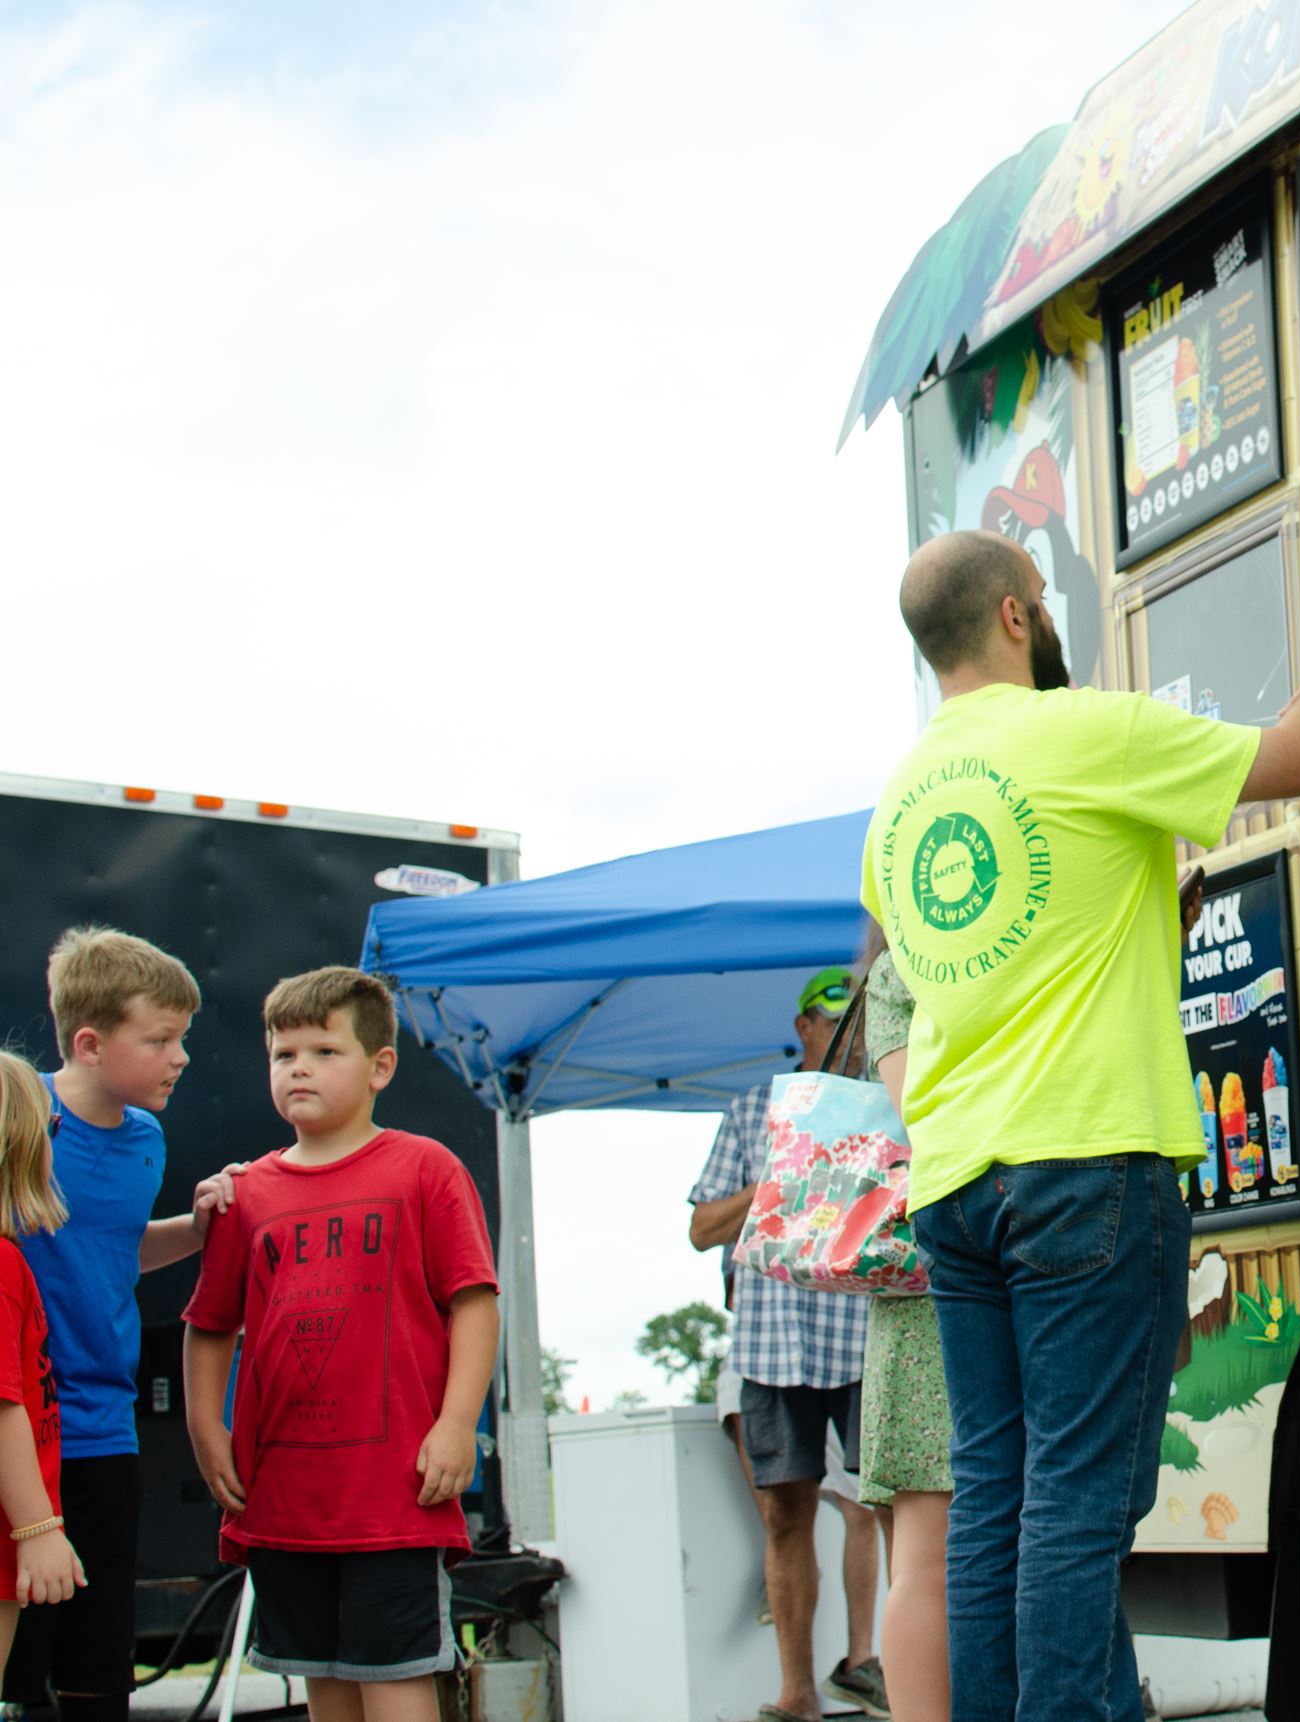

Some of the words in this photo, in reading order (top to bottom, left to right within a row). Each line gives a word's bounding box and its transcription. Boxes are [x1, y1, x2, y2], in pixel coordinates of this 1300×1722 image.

[1124, 281, 1184, 355] FRUIT
[918, 837, 937, 891] FIRST
[962, 824, 989, 862] LAST
[933, 860, 967, 881] SAFETY
[929, 894, 983, 923] ALWAYS
[1188, 892, 1245, 952] PICK
[907, 951, 961, 984] ALLOY
[965, 919, 1032, 980] CRANE
[1184, 949, 1223, 983] YOUR
[1224, 940, 1254, 972] CUP.
[1195, 1003, 1213, 1023] THE
[262, 1213, 383, 1276] AERO
[271, 1286, 343, 1306] GISTERED
